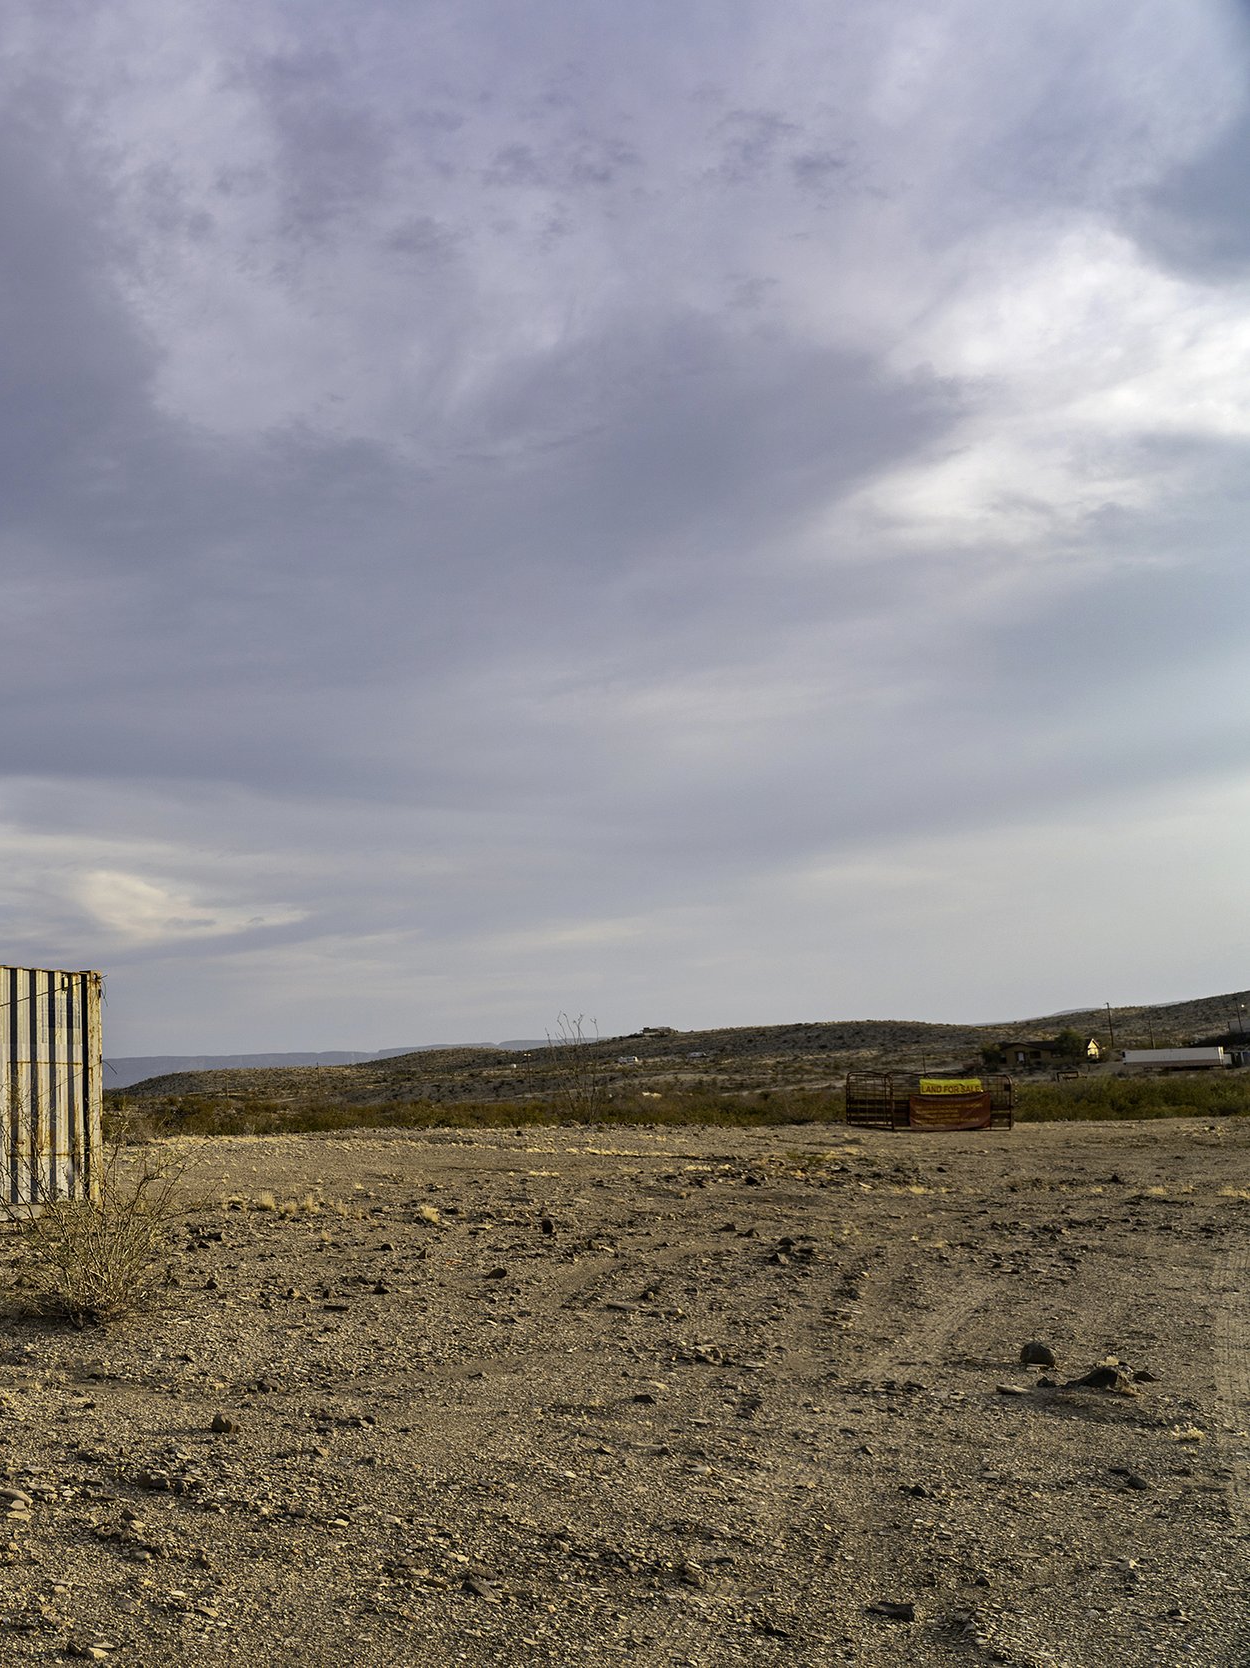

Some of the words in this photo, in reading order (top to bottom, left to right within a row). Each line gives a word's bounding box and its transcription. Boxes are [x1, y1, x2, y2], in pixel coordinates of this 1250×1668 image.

[921, 1085, 942, 1093] LAND
[943, 1085, 959, 1093] FOR
[960, 1085, 981, 1093] SALE
